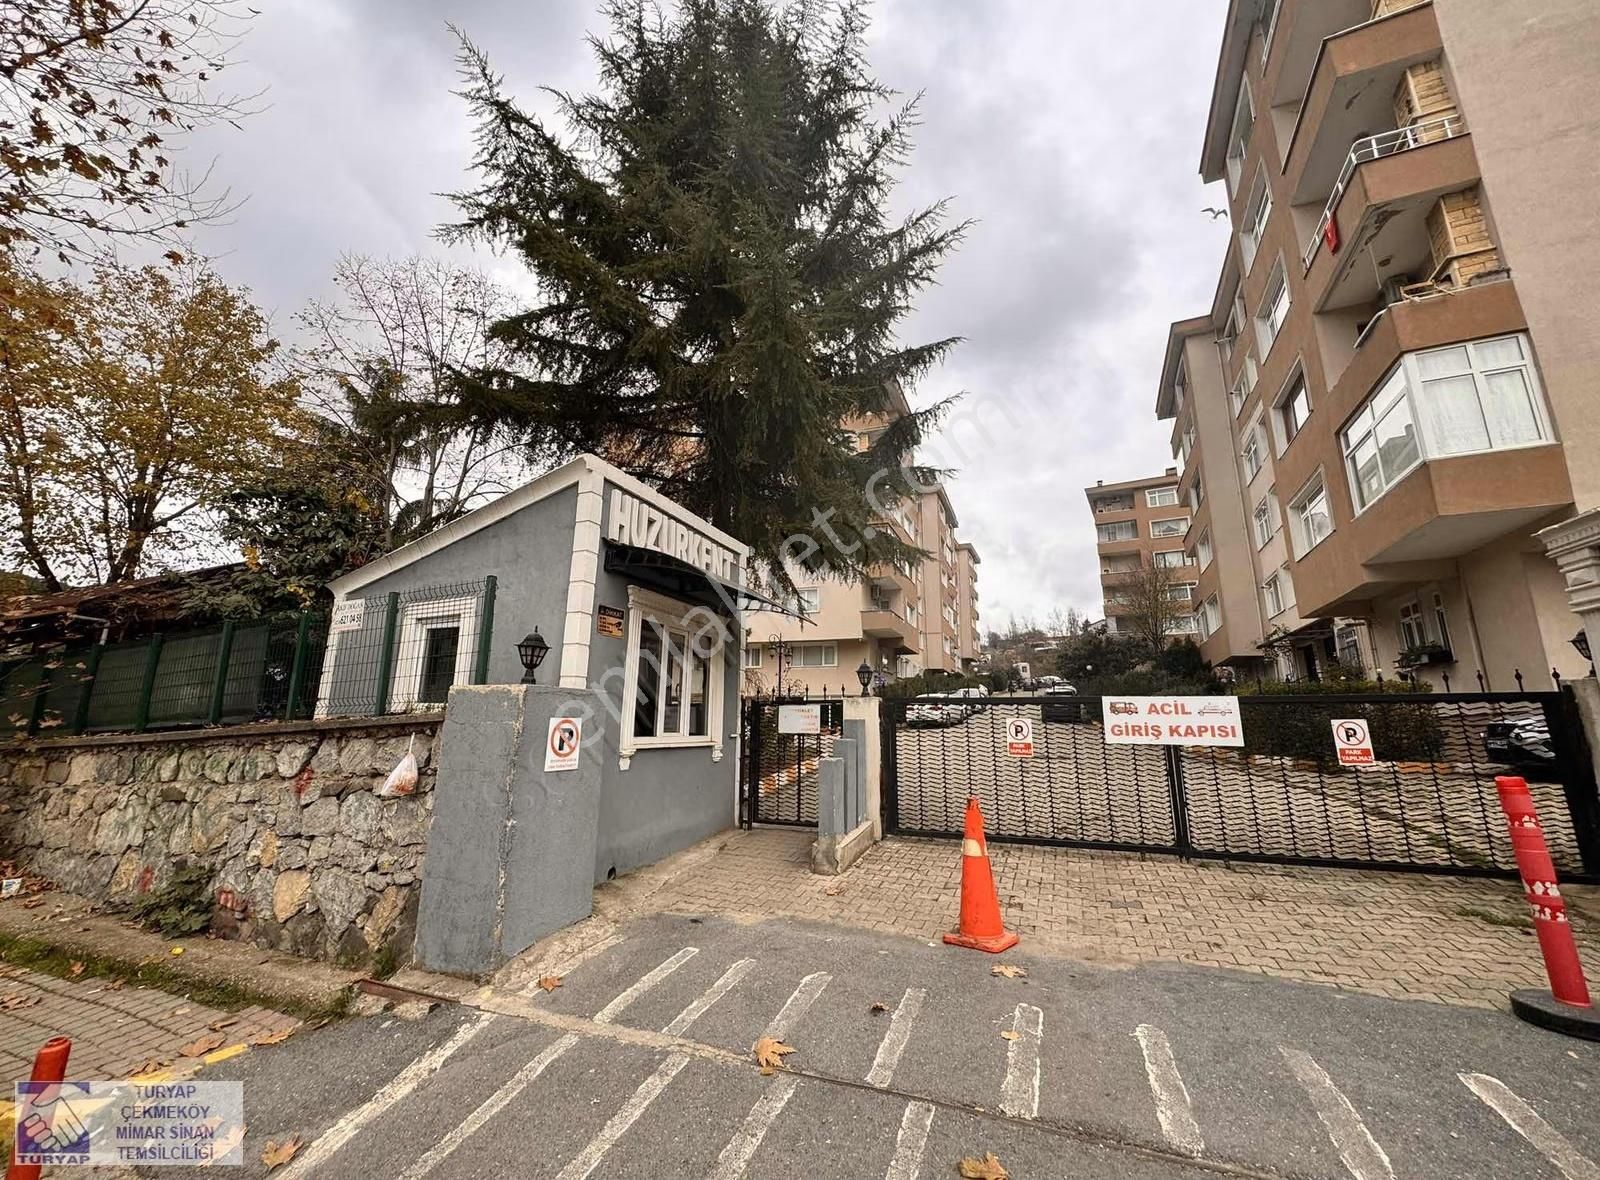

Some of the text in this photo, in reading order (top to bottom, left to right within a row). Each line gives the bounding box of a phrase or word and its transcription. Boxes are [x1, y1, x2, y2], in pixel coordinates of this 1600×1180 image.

[608, 488, 733, 580] HUZURKENT
[1147, 700, 1192, 715] ACİL
[1110, 722, 1237, 740] GİRİŞ KAPISI
